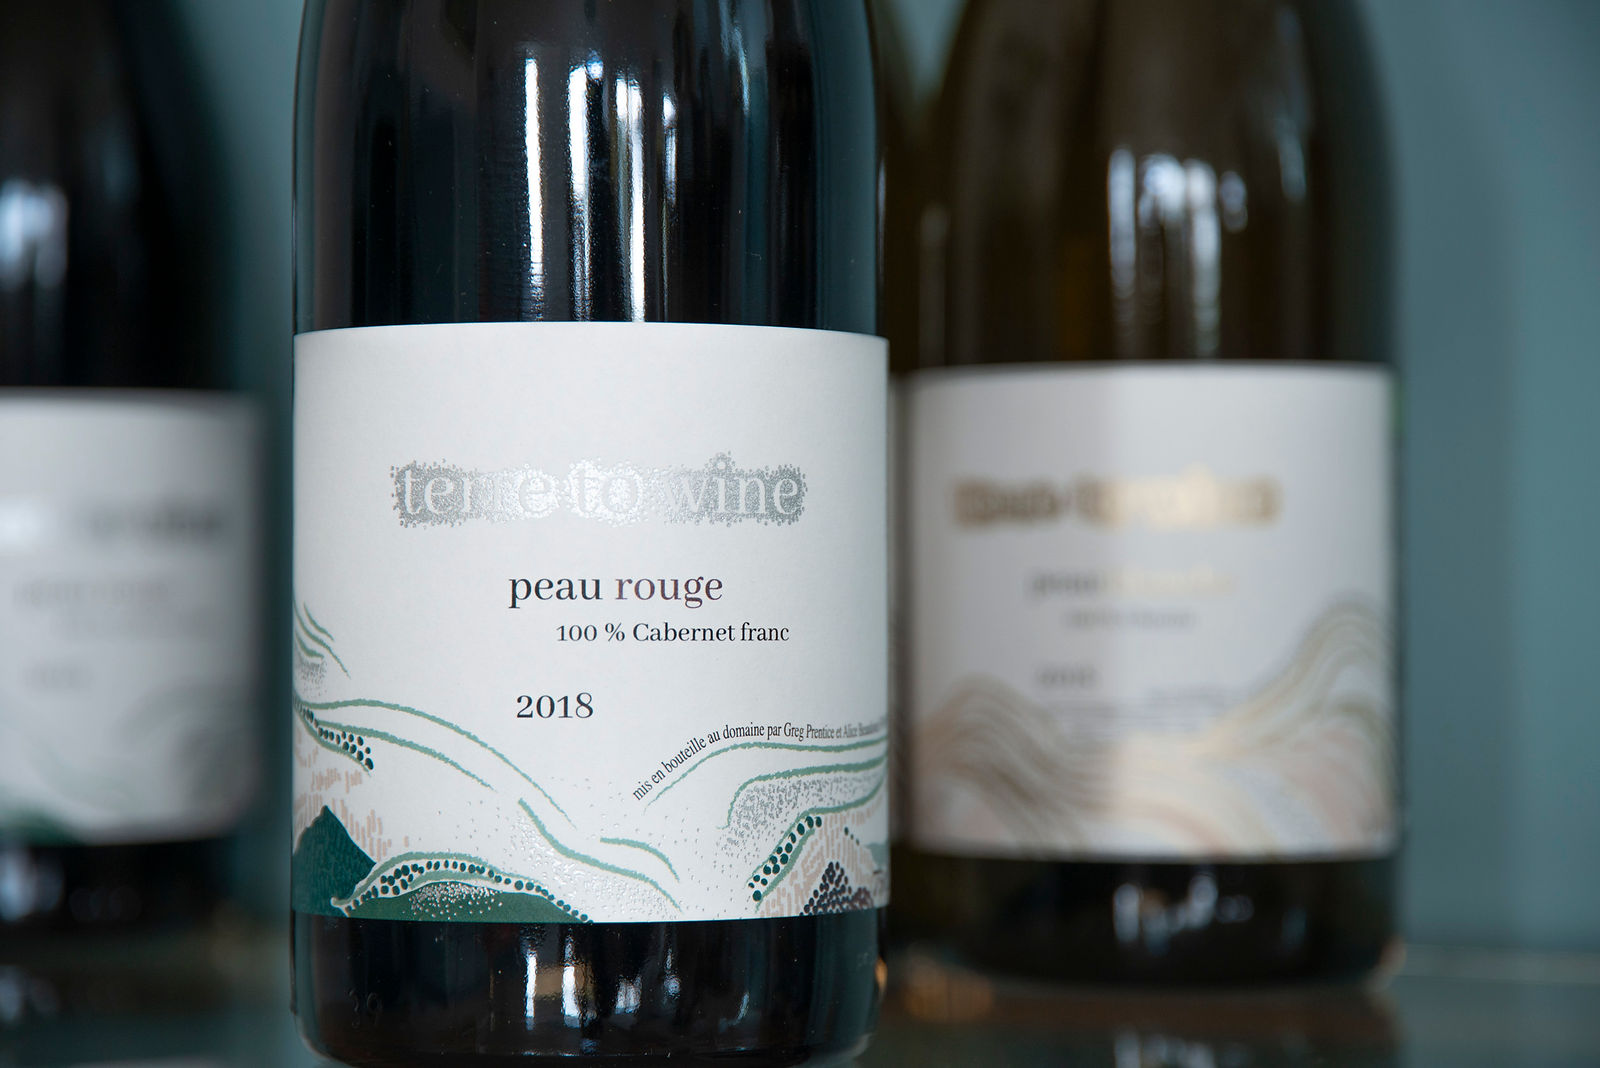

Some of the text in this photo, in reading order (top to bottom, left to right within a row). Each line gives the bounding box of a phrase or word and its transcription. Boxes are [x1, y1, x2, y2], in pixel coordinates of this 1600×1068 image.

[401, 460, 799, 516] terre to wine
[507, 576, 723, 610] peau rouge
[556, 621, 790, 642] 100 % Cabernet franc
[516, 691, 594, 719] 2018
[633, 781, 653, 800] mis
[651, 769, 666, 784] en
[661, 738, 707, 773] bouteille
[707, 730, 721, 744] au
[722, 721, 765, 739] domaine
[767, 725, 782, 740] par
[784, 722, 804, 741] Greg
